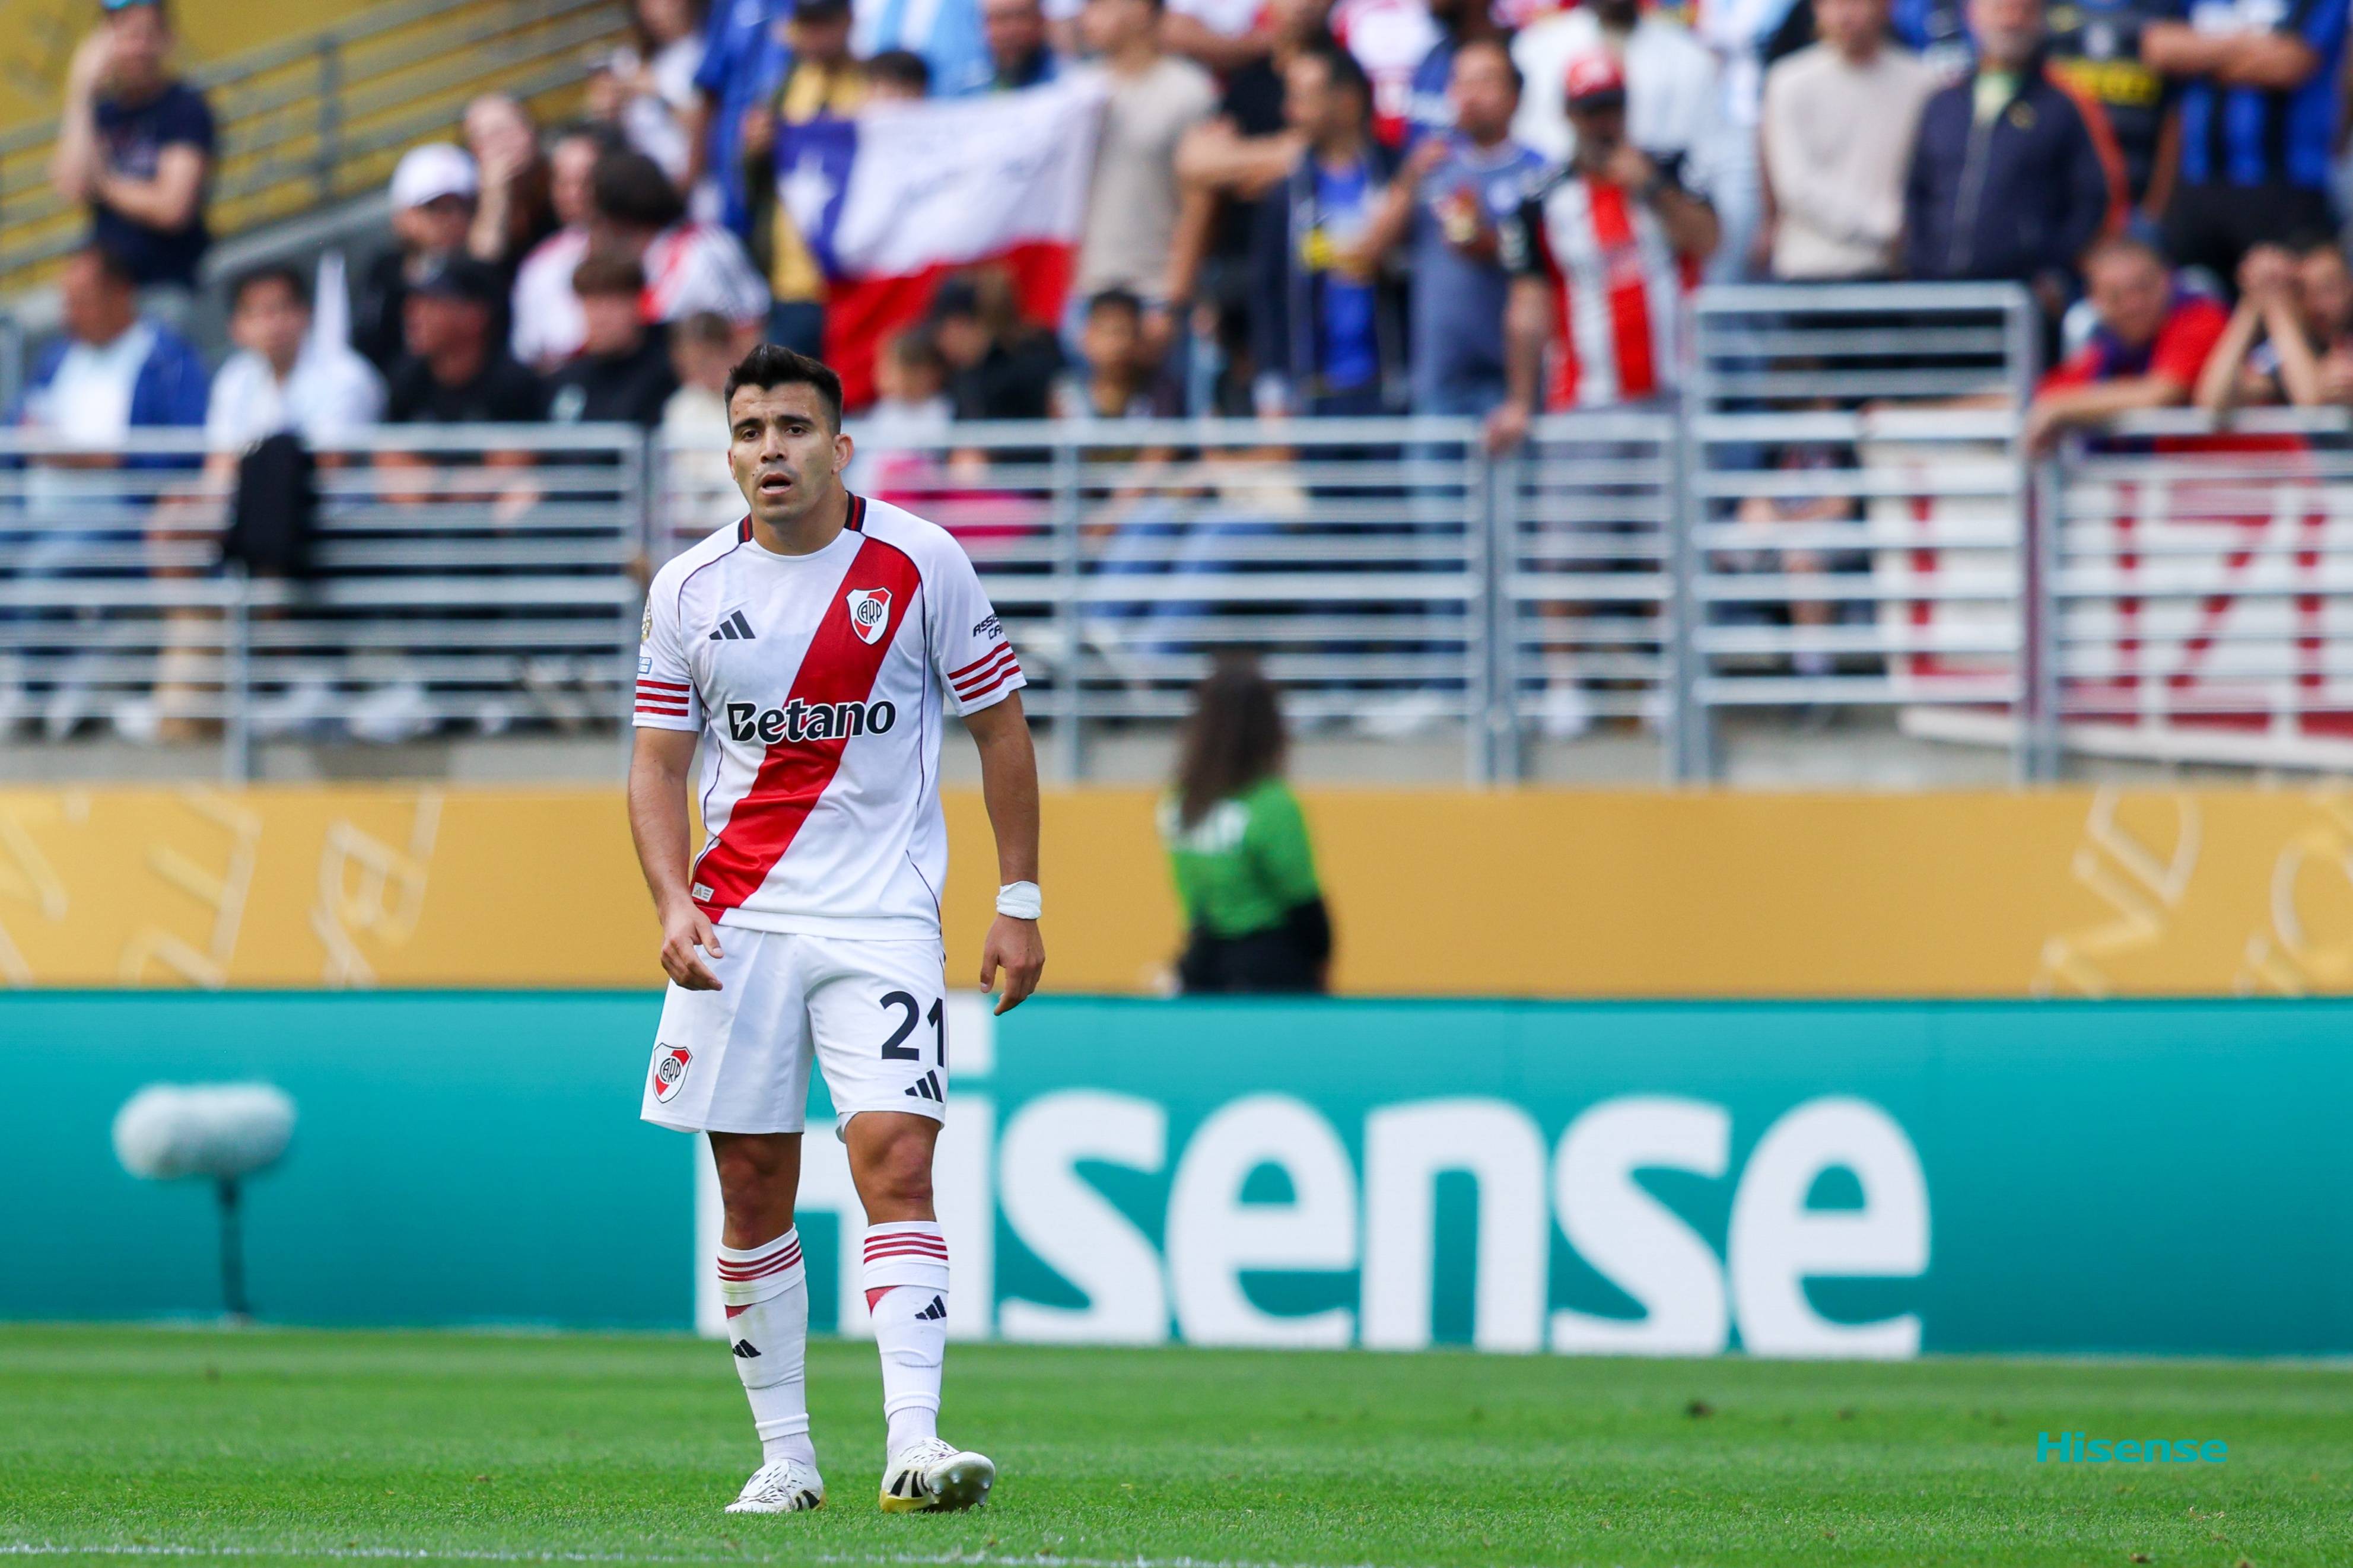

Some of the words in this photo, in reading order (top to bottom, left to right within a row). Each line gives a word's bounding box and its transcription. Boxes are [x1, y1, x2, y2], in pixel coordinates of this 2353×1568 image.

[857, 600, 882, 625] CARP
[727, 699, 896, 743] Betano
[879, 991, 945, 1068] 21
